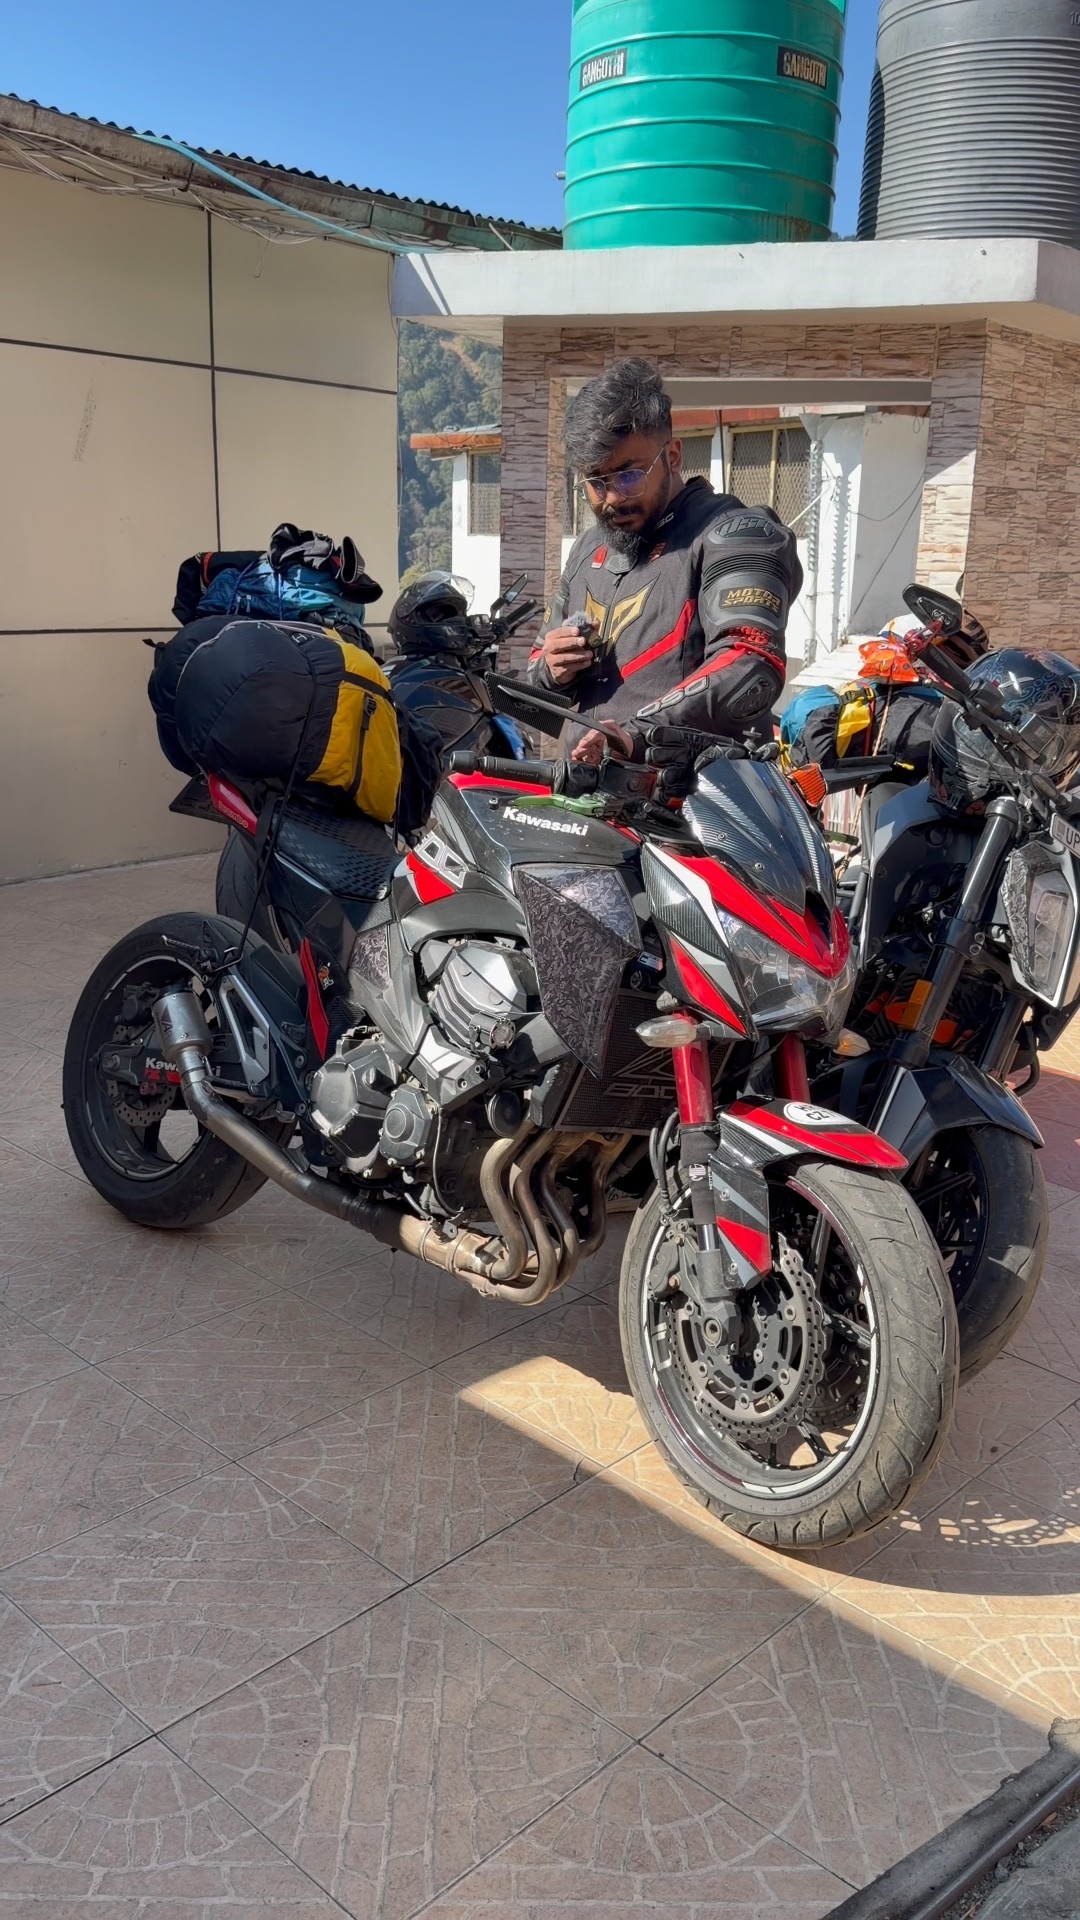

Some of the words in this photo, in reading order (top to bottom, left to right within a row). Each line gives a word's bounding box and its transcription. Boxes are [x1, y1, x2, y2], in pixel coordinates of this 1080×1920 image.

[582, 52, 625, 87] GANGOTRI
[783, 51, 827, 87] GANGOTRI
[722, 596, 780, 613] SPORTS
[726, 588, 781, 605] MOTOR
[502, 806, 589, 836] Kawasaki
